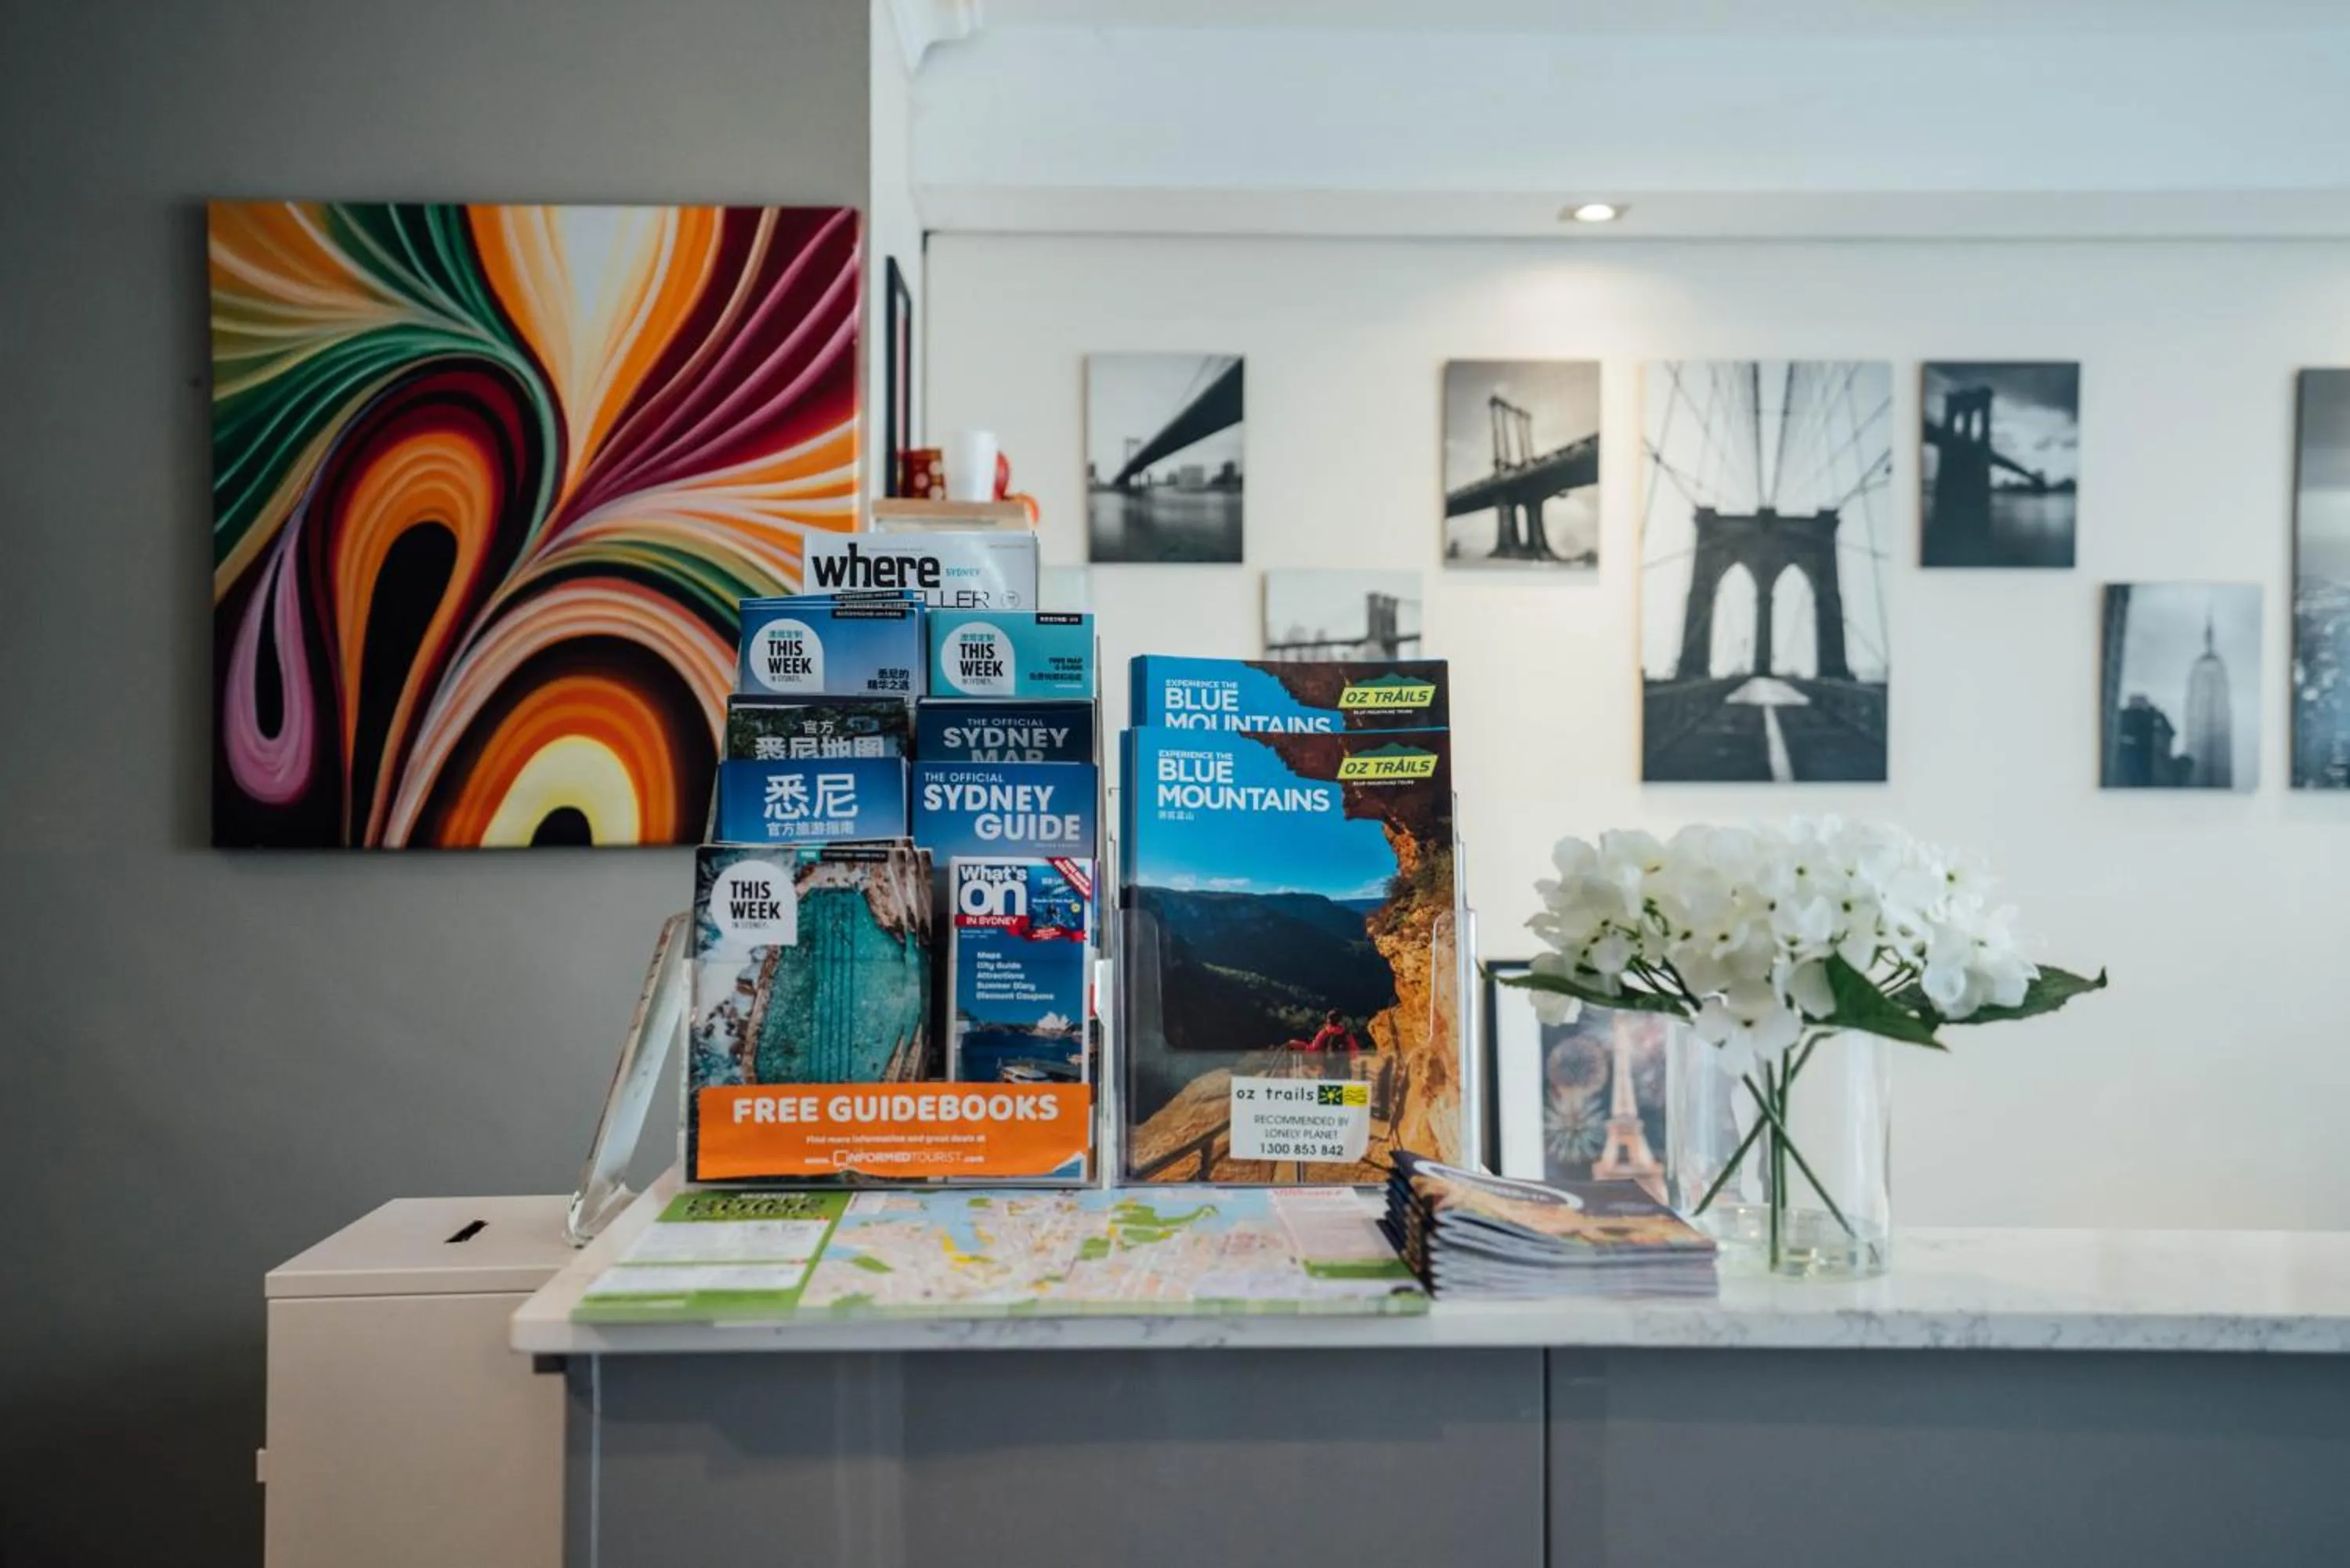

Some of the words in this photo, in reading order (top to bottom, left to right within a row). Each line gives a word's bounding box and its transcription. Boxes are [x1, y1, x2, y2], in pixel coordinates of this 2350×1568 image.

[812, 542, 940, 587] where
[945, 567, 981, 578] SYDNEY
[768, 640, 803, 656] THIS
[960, 643, 995, 659] THIS
[768, 657, 812, 674] WEEK
[960, 660, 1003, 677] WEEK
[1165, 679, 1218, 688] EXPERIENCE
[1221, 681, 1238, 689] THE
[1165, 688, 1239, 712] BLUE
[1346, 692, 1370, 703] OZ
[1374, 688, 1430, 703] TRAILS
[802, 720, 834, 735] 官方
[991, 717, 1045, 727] OFFICIAL
[1165, 713, 1332, 734] MOUNTAINS
[942, 728, 1070, 748] SYDNEY
[971, 749, 1046, 763] MAP
[1158, 750, 1213, 760] EXPERIENCE
[1216, 751, 1233, 761] THE
[1158, 759, 1235, 784] BLUE
[1344, 762, 1370, 775] OZ
[1374, 758, 1431, 774] TRAILS
[924, 772, 945, 782] THE
[949, 772, 1003, 782] OFFICIAL
[763, 773, 859, 820] 悉尼
[924, 784, 1055, 812] SYDNEY
[1158, 784, 1331, 812] MOUNTAINS
[974, 813, 1081, 841] GUIDE
[960, 865, 1028, 882] What's
[729, 880, 772, 899] THIS
[960, 880, 1028, 916] on
[729, 901, 781, 919] WEEK
[966, 916, 977, 925] IN
[979, 916, 1018, 926] SYDNEY
[996, 961, 1021, 970] Guide
[976, 971, 1025, 980] Attractions
[1236, 1088, 1256, 1100] oz
[1266, 1086, 1314, 1100] trails
[732, 1097, 819, 1124] FREE
[826, 1094, 1060, 1122] GUIDEBOOKS
[1253, 1114, 1336, 1126] RECOMMENDED
[1338, 1115, 1350, 1127] BY
[806, 1135, 826, 1143] Find
[851, 1134, 906, 1143] information
[906, 1134, 924, 1143] and
[925, 1135, 949, 1144] great
[950, 1134, 974, 1143] deals
[1264, 1129, 1301, 1139] LONELY
[1303, 1130, 1338, 1140] PLANET
[1260, 1143, 1290, 1155] 1300
[1293, 1143, 1318, 1155] 853
[1320, 1144, 1344, 1156] 842
